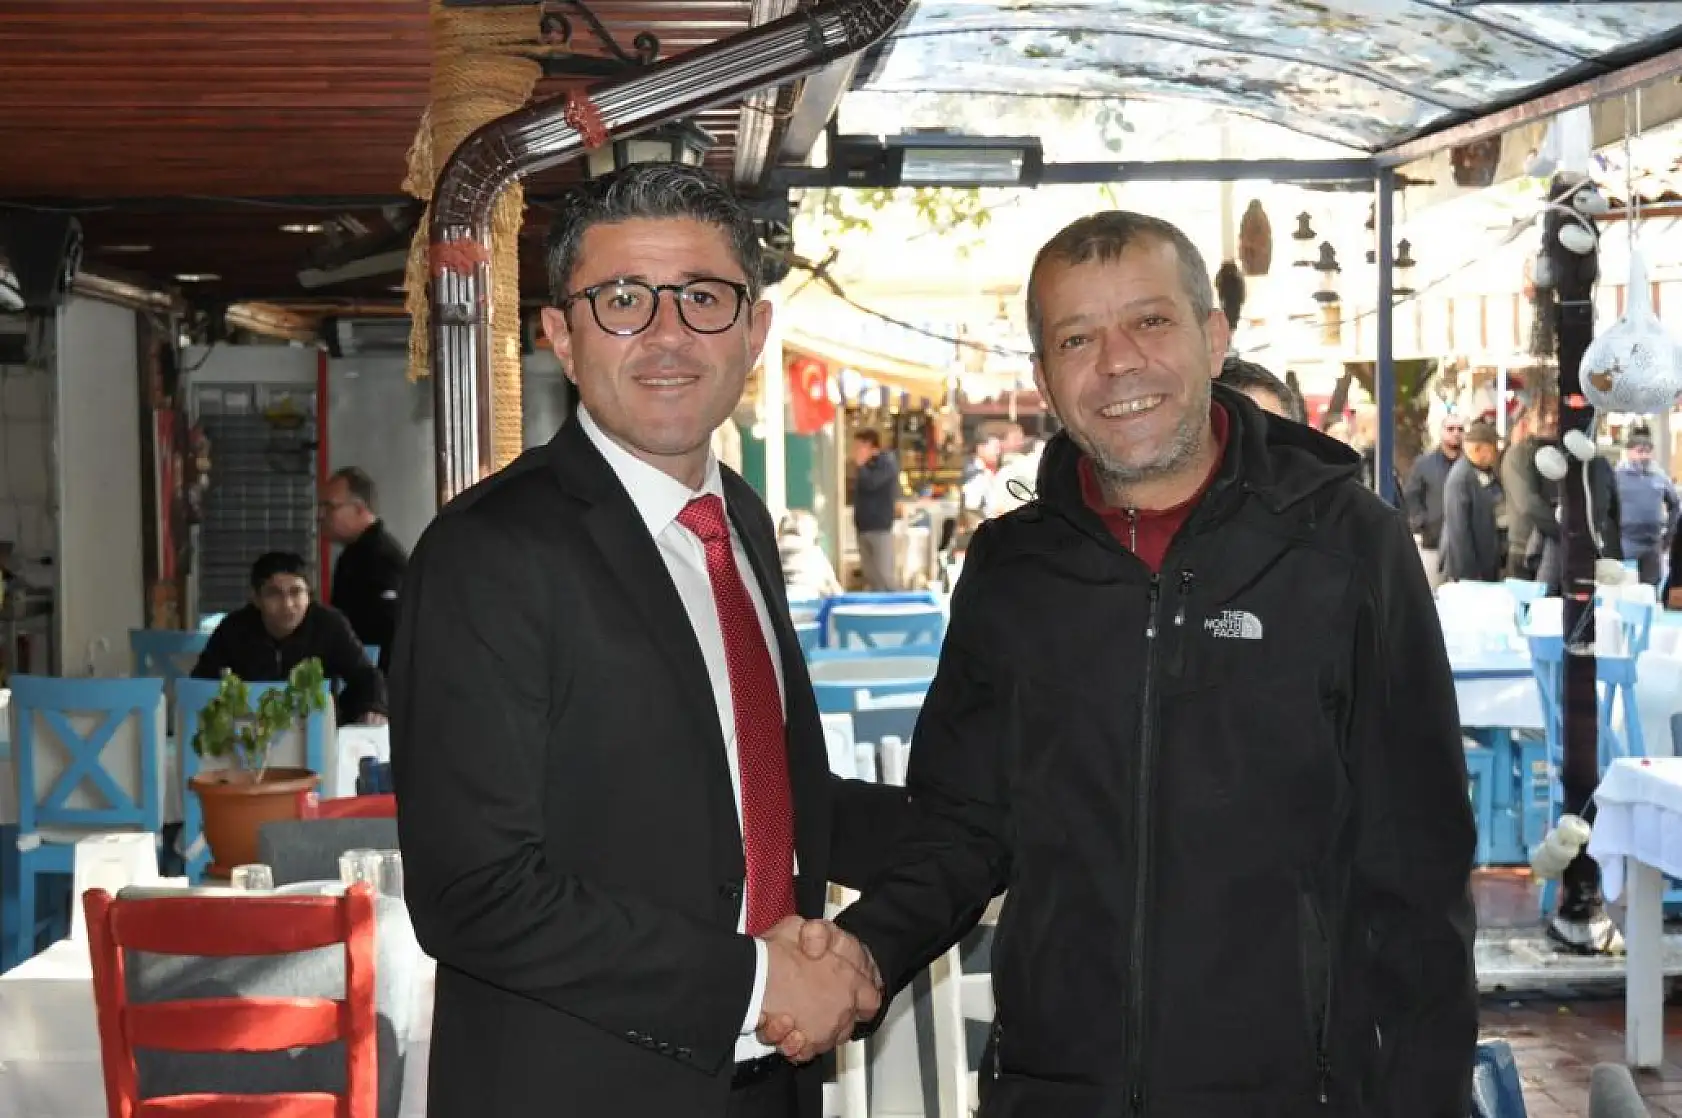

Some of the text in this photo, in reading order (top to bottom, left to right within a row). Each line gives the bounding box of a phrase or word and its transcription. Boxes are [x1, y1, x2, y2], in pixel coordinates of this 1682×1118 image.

[1221, 610, 1244, 620] THE
[1204, 619, 1241, 630] NORTH
[1213, 628, 1241, 638] FACE
